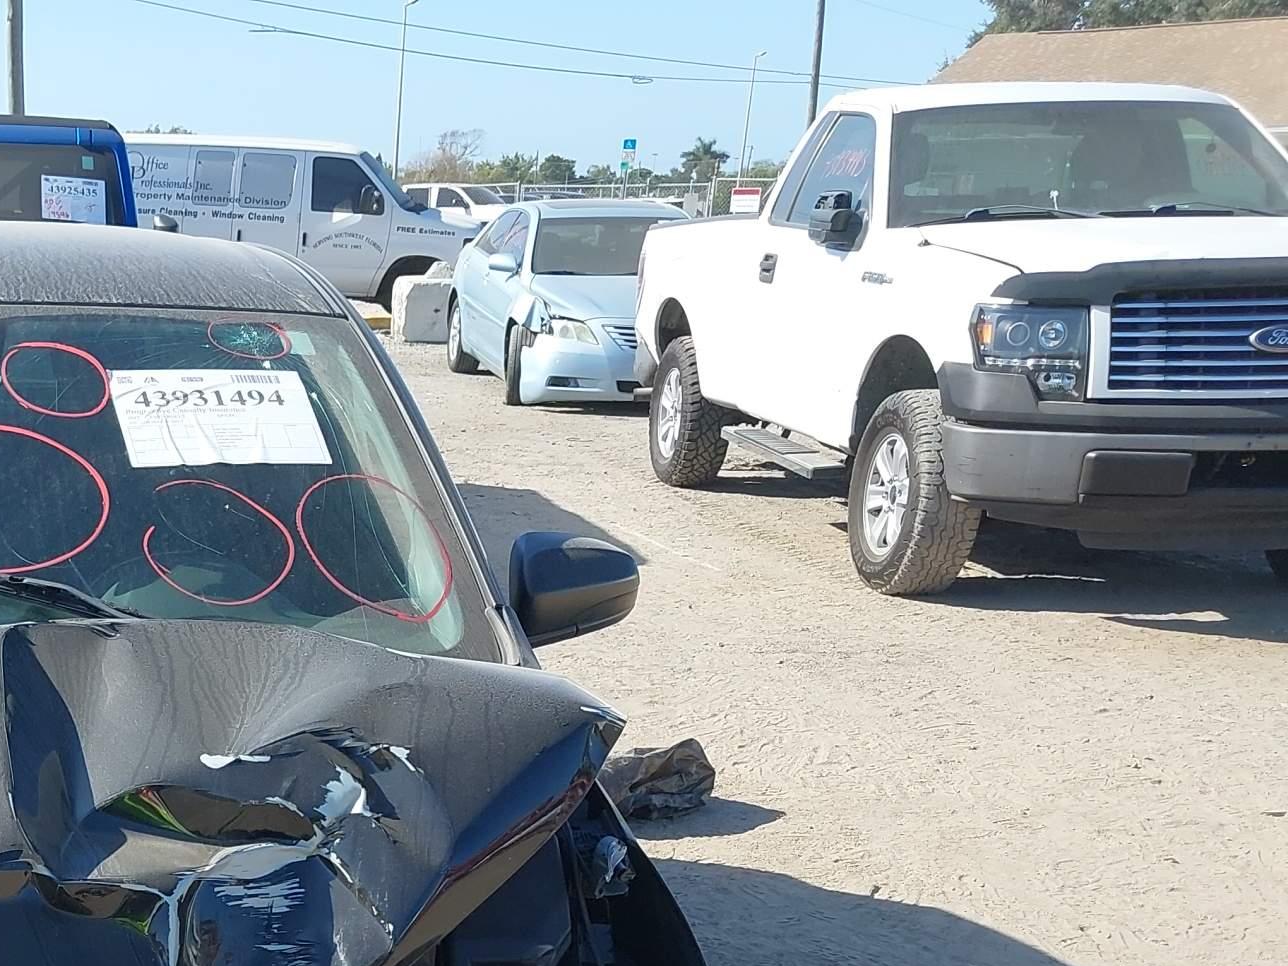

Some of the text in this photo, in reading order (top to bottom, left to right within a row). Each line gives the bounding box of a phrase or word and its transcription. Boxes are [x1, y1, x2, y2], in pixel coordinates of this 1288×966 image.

[47, 185, 98, 198] 43925435
[134, 192, 287, 207] roperty Maintenance Division
[212, 209, 245, 219] Window
[248, 211, 285, 223] Cleaning
[396, 226, 456, 237] FREE Estimates
[134, 389, 286, 408] 43931494
